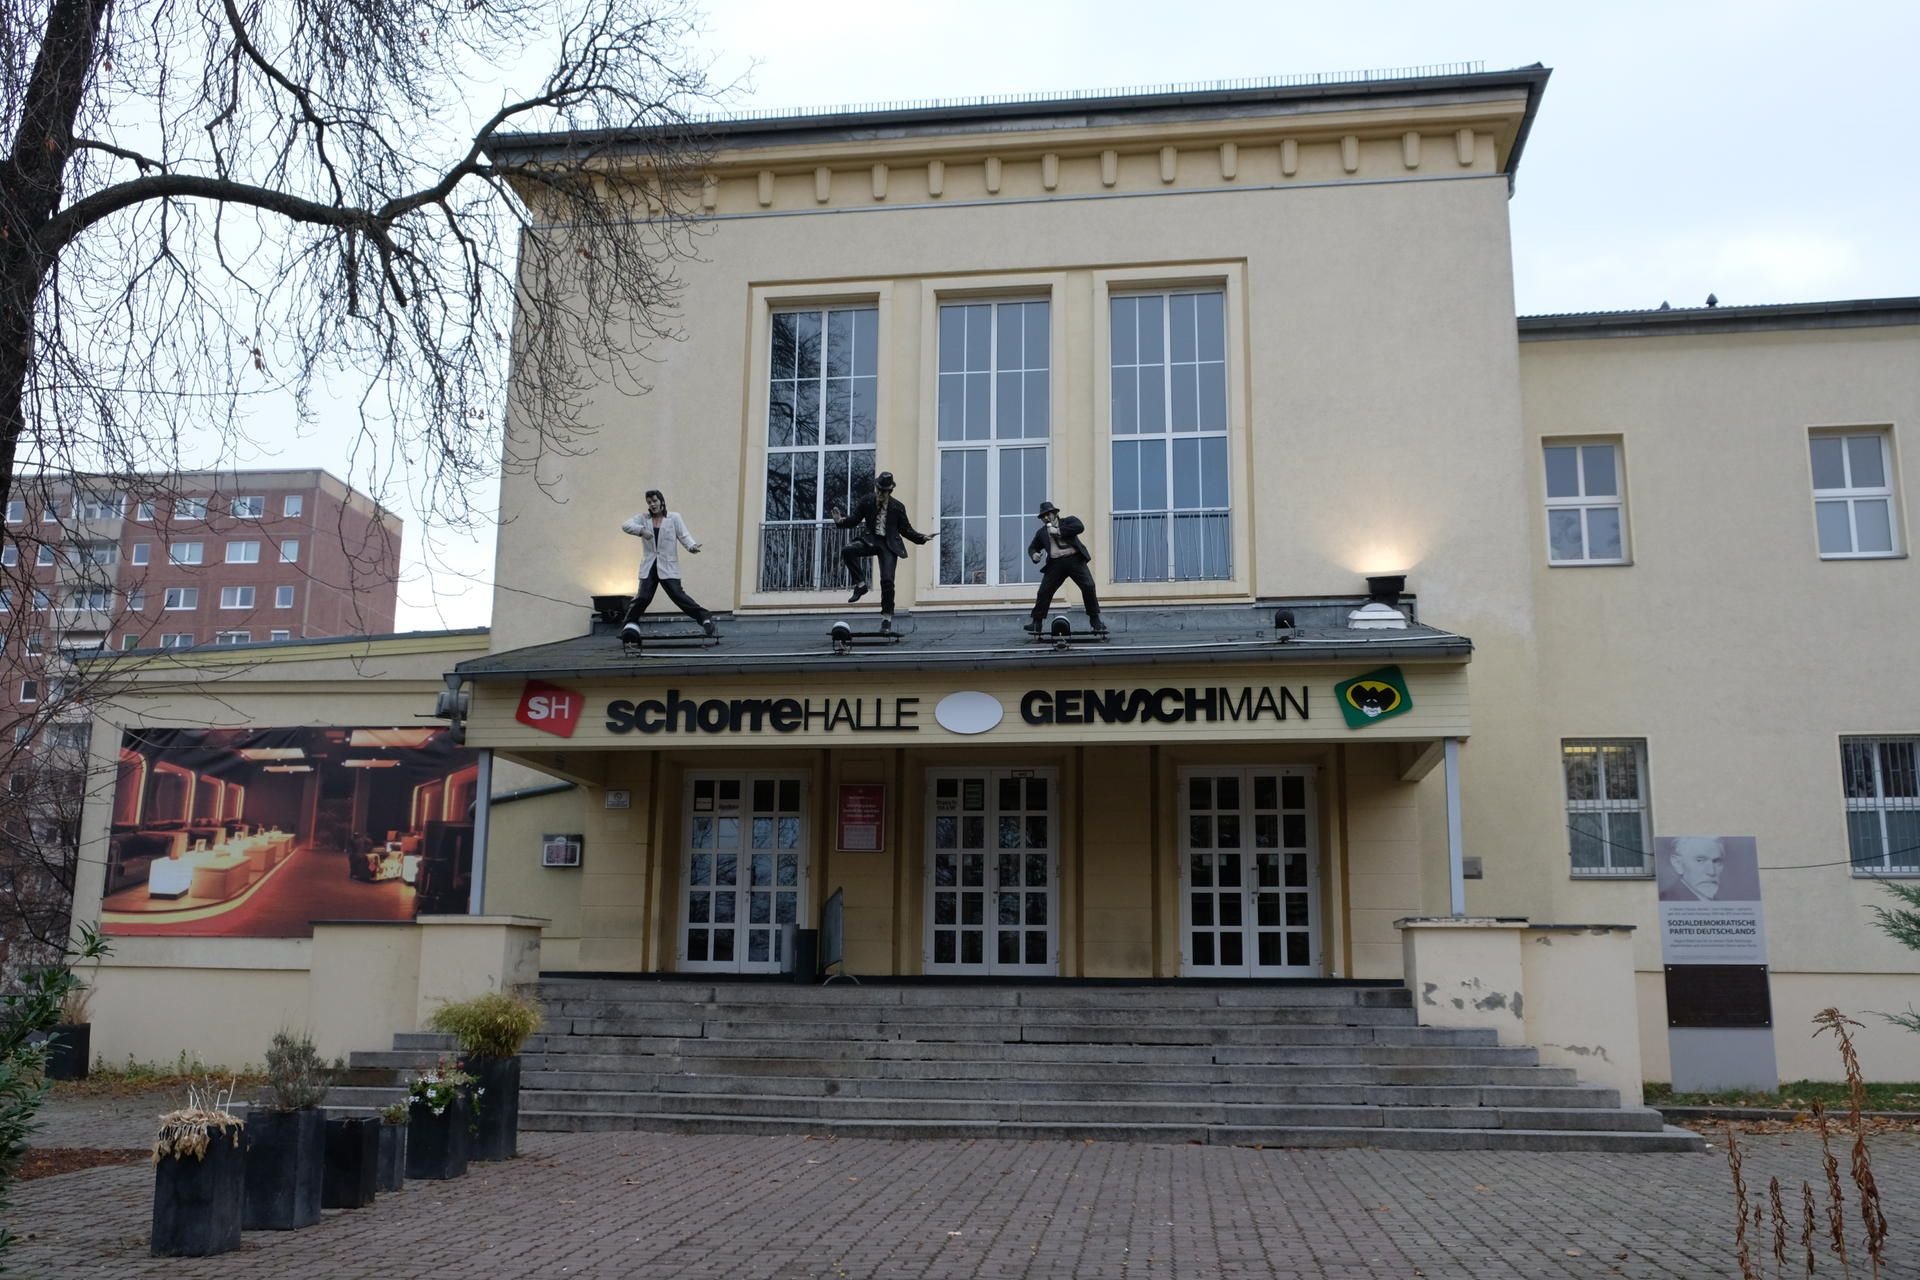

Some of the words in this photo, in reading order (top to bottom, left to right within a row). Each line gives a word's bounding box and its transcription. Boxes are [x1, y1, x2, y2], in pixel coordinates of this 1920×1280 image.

[527, 695, 569, 720] SH
[605, 689, 920, 734] schorreHALLE
[1020, 685, 1310, 725] GENSCHMAN
[1667, 919, 1756, 927] SOZIALDEMOKRATISCHE
[1669, 927, 1695, 935] PARTEI
[1696, 927, 1757, 935] DEUTSCHLANDS
